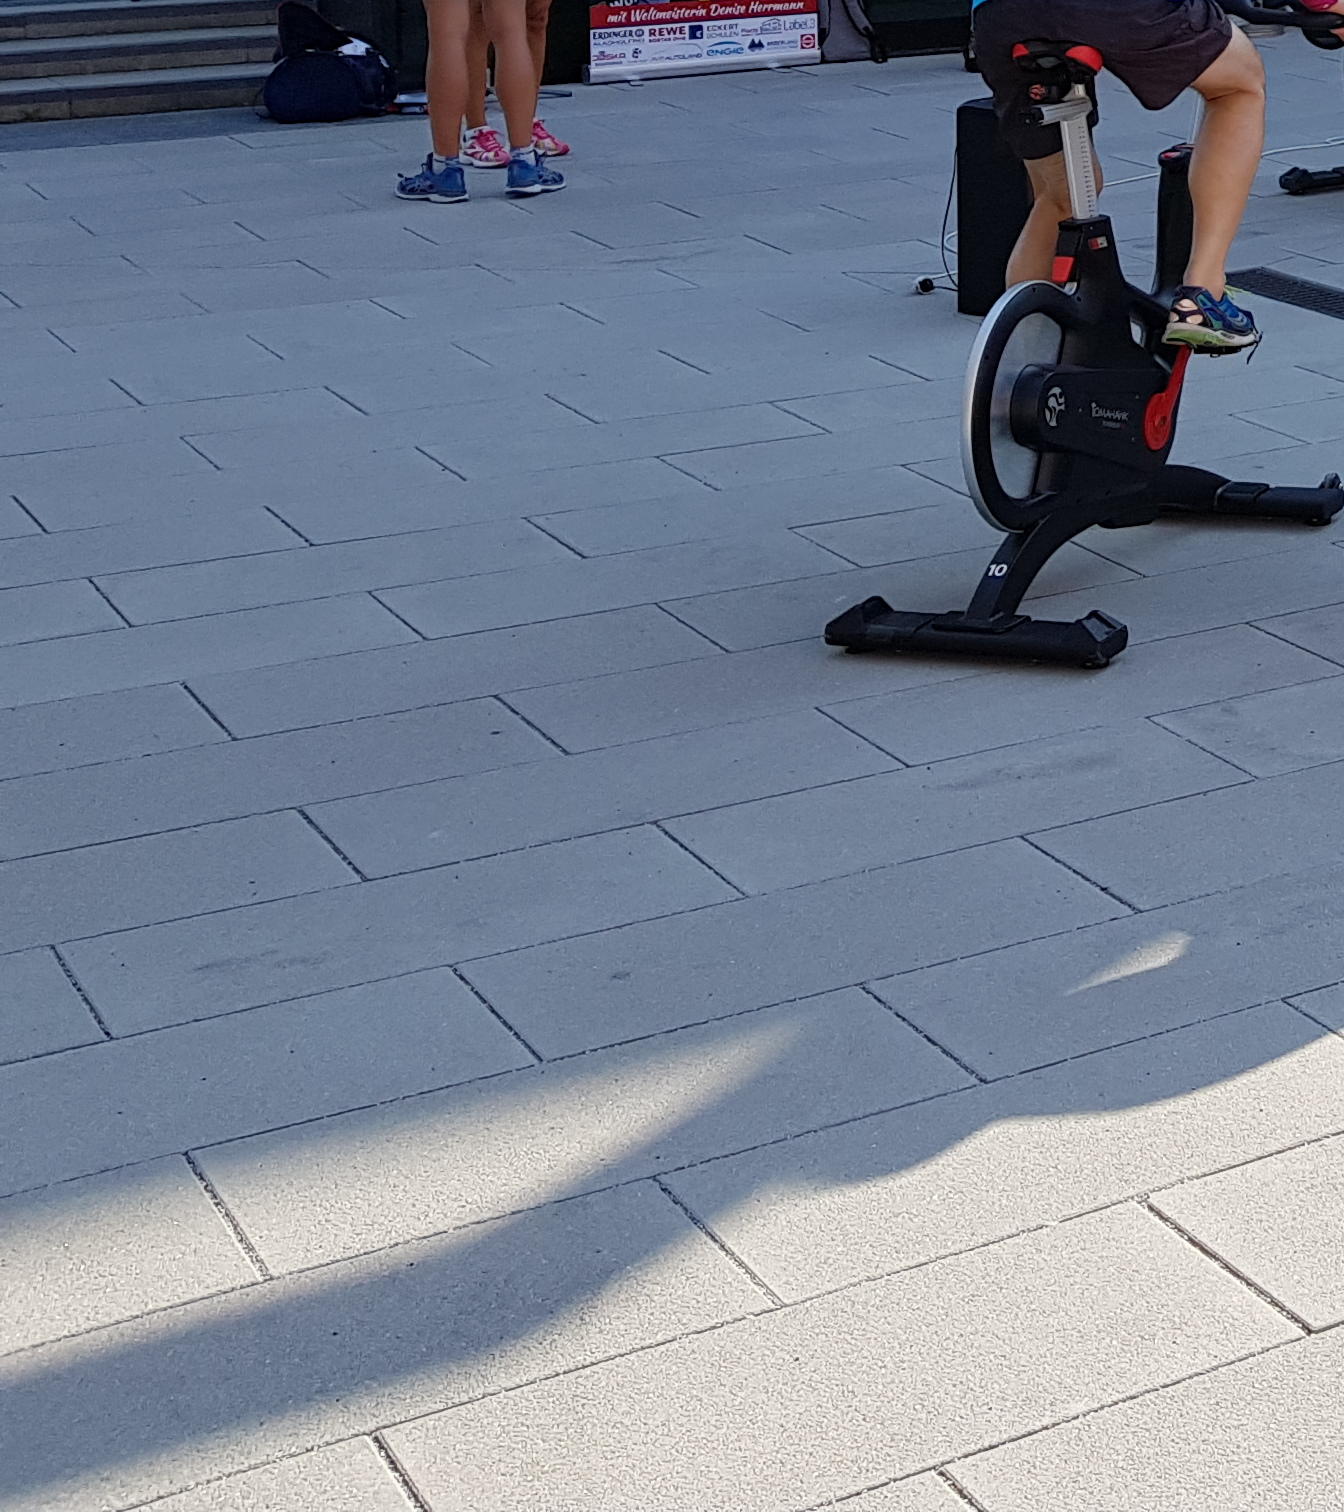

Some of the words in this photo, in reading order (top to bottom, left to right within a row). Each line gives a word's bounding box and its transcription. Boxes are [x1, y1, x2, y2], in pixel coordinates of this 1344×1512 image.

[607, 11, 628, 23] mit
[630, 5, 706, 22] Weltmeisterin
[710, 3, 747, 16] Denise
[748, 1, 804, 14] Herrmann
[649, 26, 686, 37] REWE
[987, 563, 1008, 577] 10
